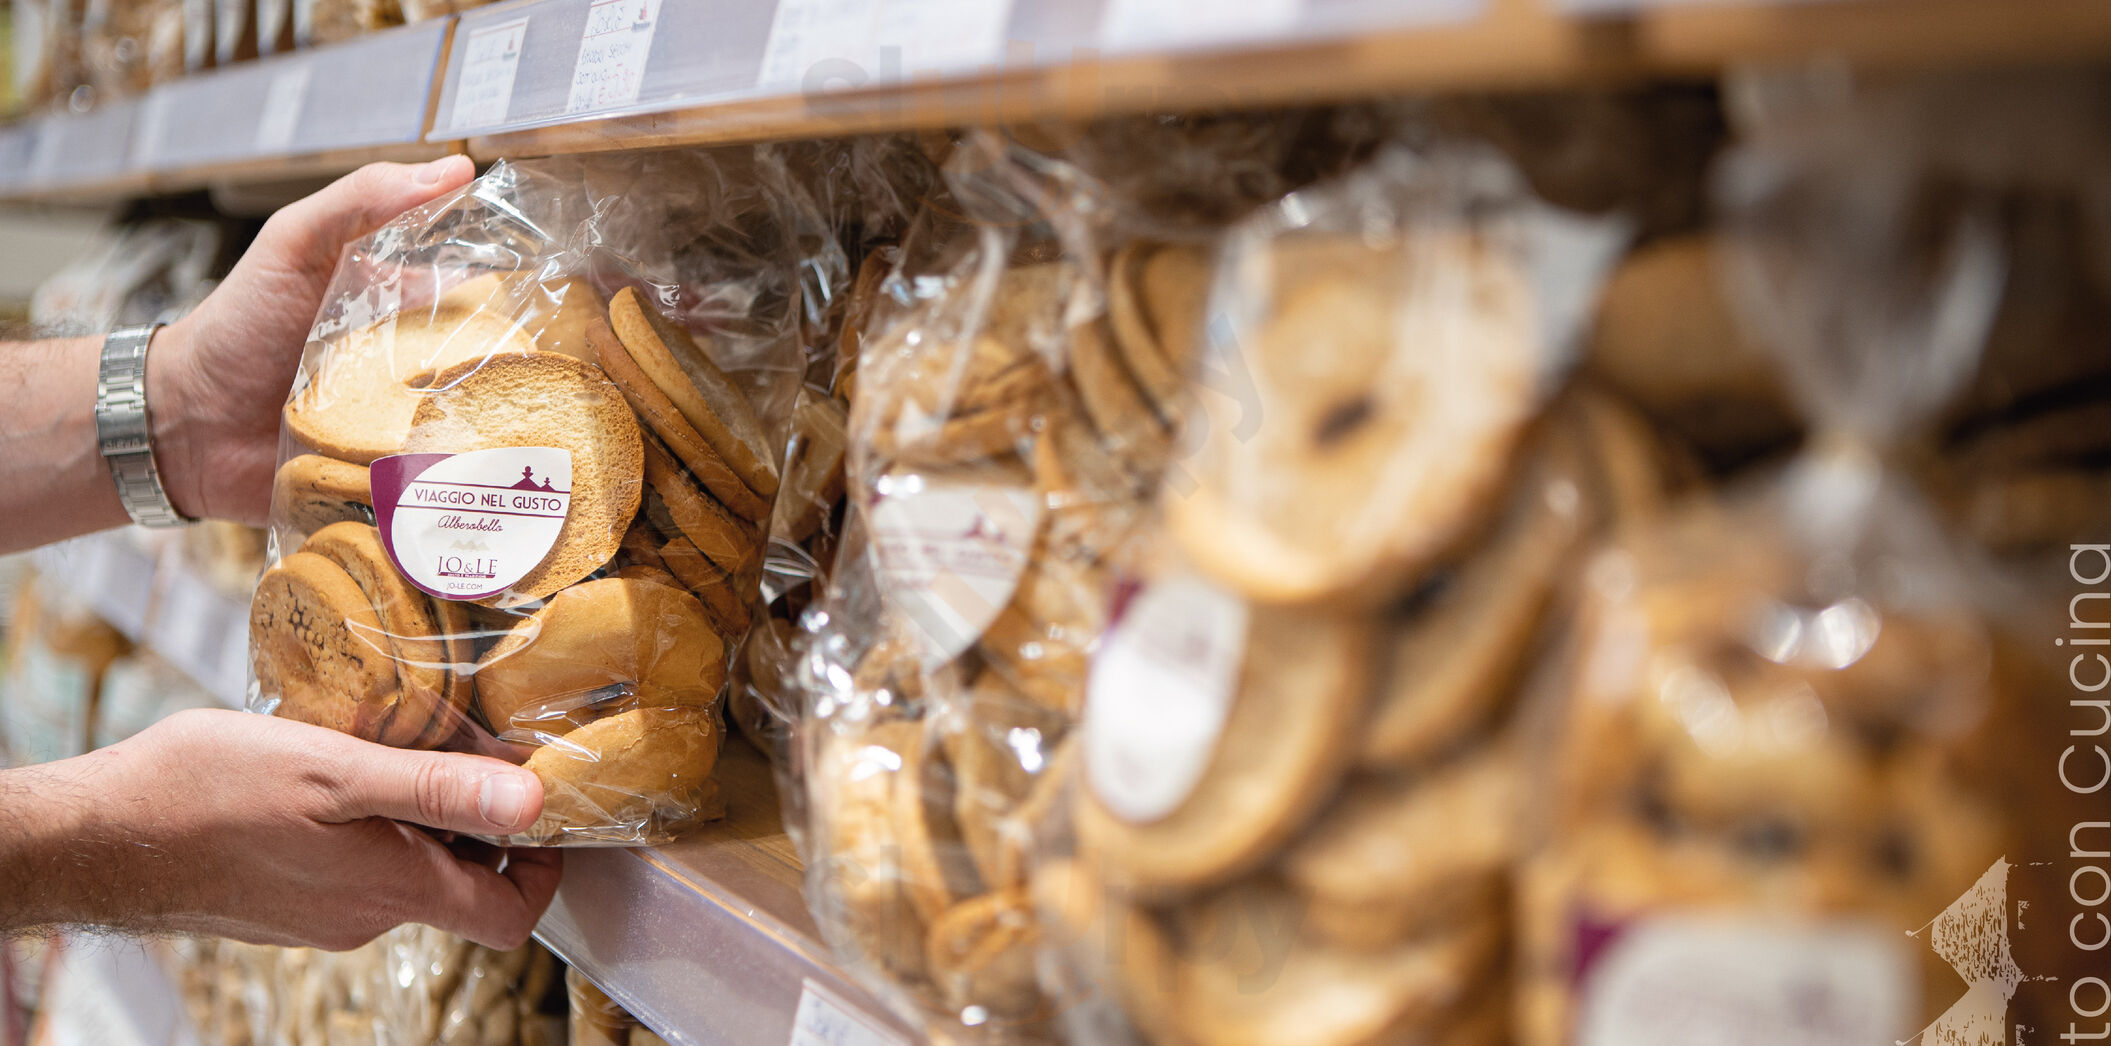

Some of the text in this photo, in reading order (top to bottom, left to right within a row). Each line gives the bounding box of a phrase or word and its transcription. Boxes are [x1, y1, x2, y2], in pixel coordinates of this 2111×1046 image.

[415, 489, 562, 511] VIAGGIO NEL GUSTO
[437, 514, 504, 532] Alberobello
